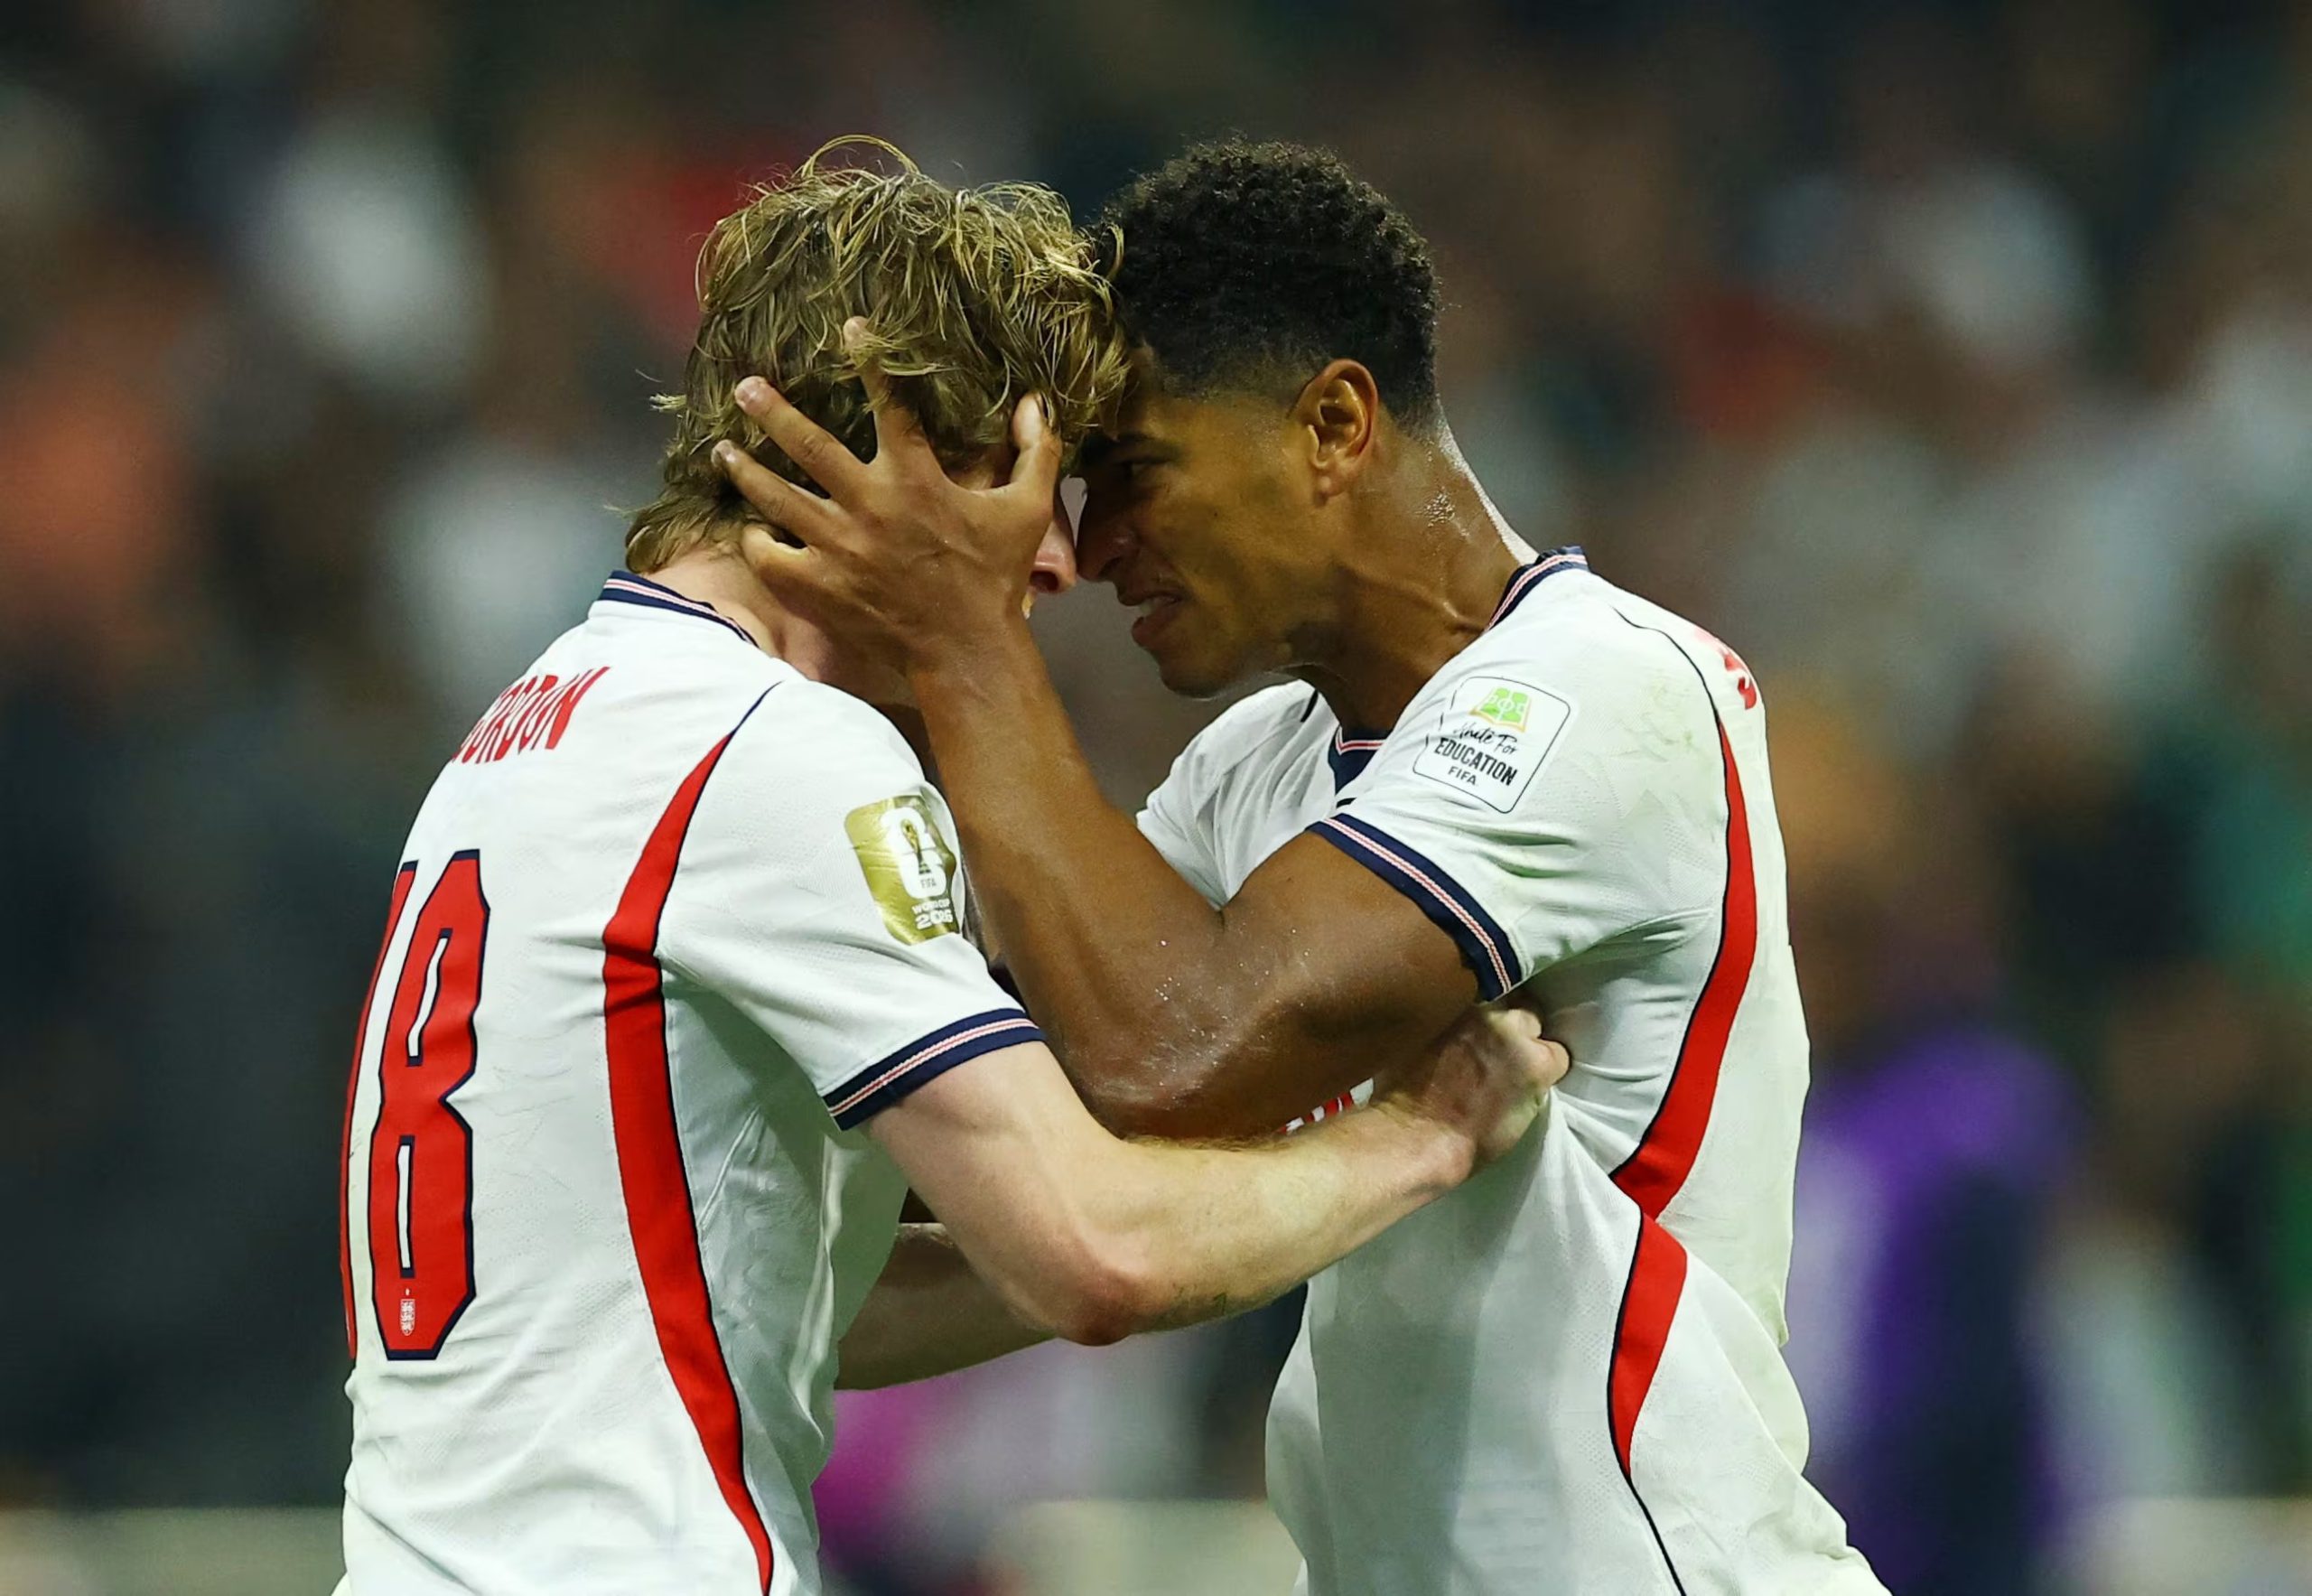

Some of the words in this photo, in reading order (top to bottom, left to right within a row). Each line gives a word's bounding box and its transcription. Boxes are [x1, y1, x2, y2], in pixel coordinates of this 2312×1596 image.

[1494, 733, 1519, 755] For
[1434, 737, 1518, 786] EDUCATION
[1447, 766, 1477, 786] FIFA
